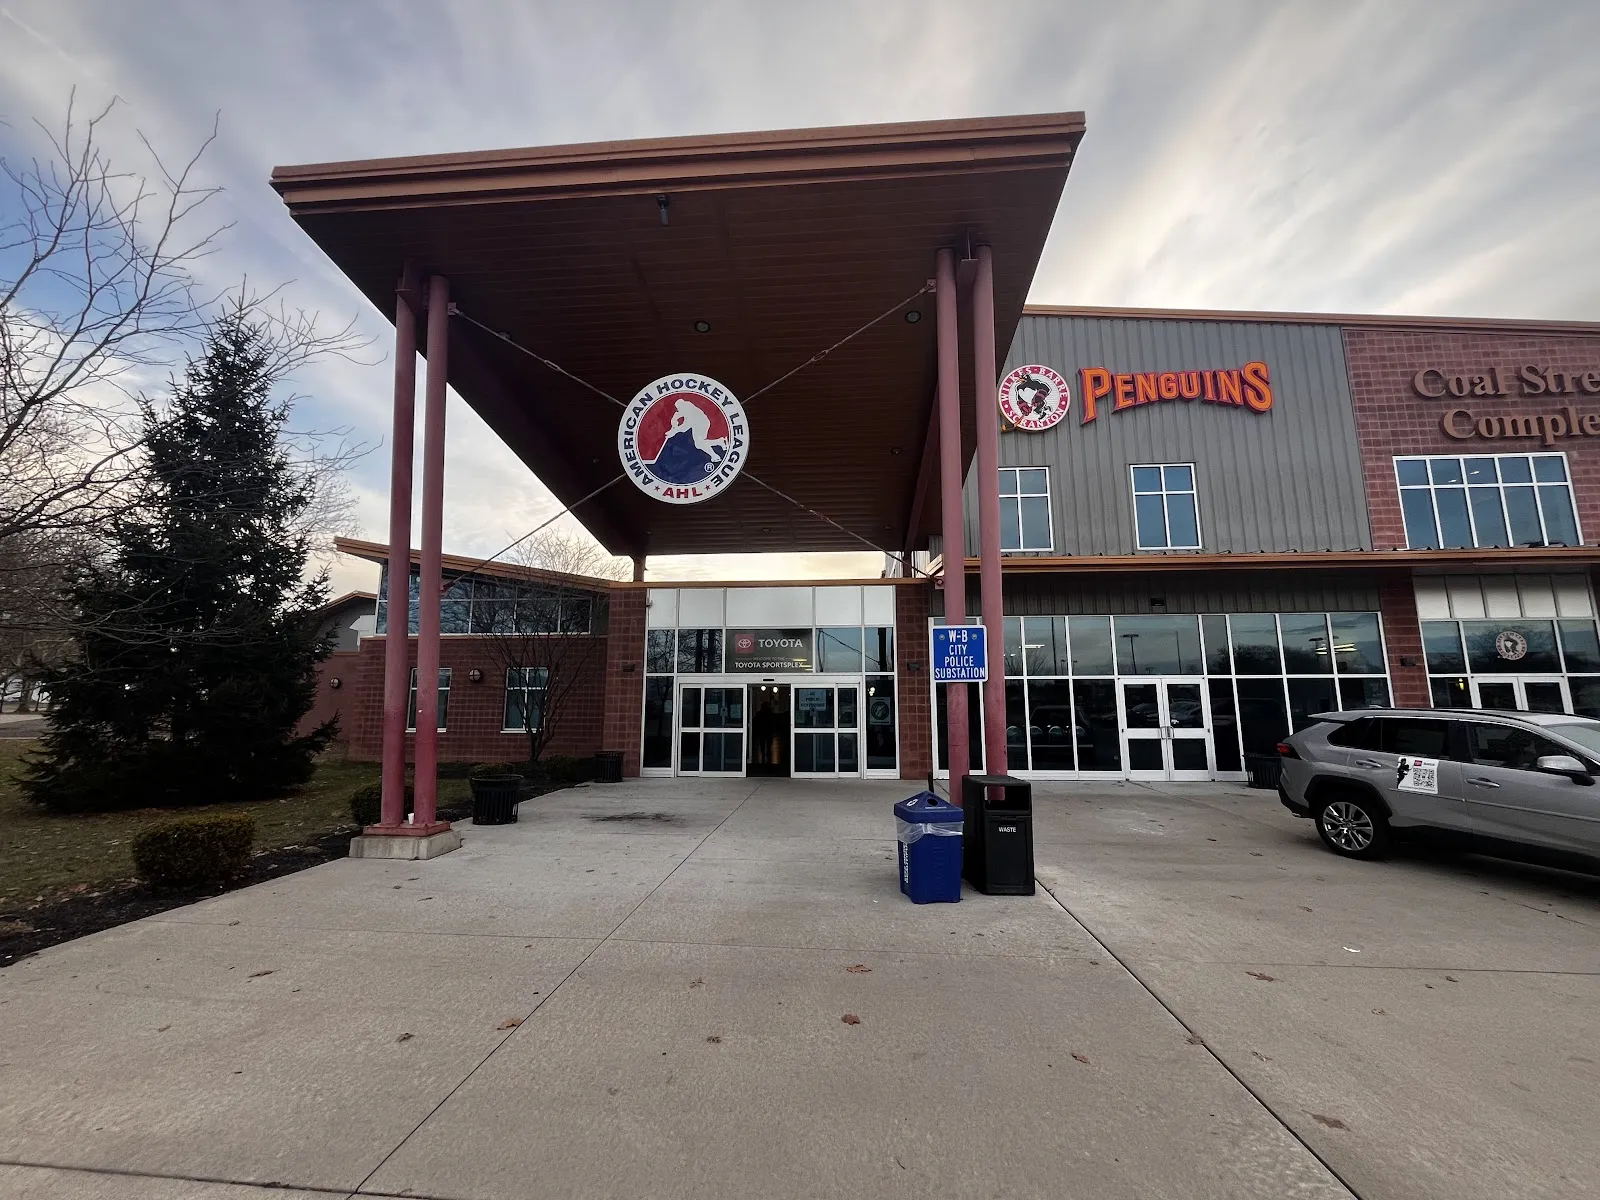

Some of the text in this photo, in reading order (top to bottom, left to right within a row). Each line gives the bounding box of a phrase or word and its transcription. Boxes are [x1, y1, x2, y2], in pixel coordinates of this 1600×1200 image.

[1001, 367, 1068, 400] WILKES-BARRE
[1413, 366, 1509, 398] Coal
[1078, 361, 1273, 427] PENGUINS
[1007, 407, 1065, 428] SCRANTON
[624, 378, 743, 487] AMERICAN HOCKEY LEAGUE
[662, 487, 703, 498] AHL
[948, 630, 968, 642] W-B
[758, 639, 803, 647] TOYOTA
[949, 645, 967, 655] CITY
[944, 656, 974, 667] POLICE
[935, 667, 985, 679] SUBSTATION
